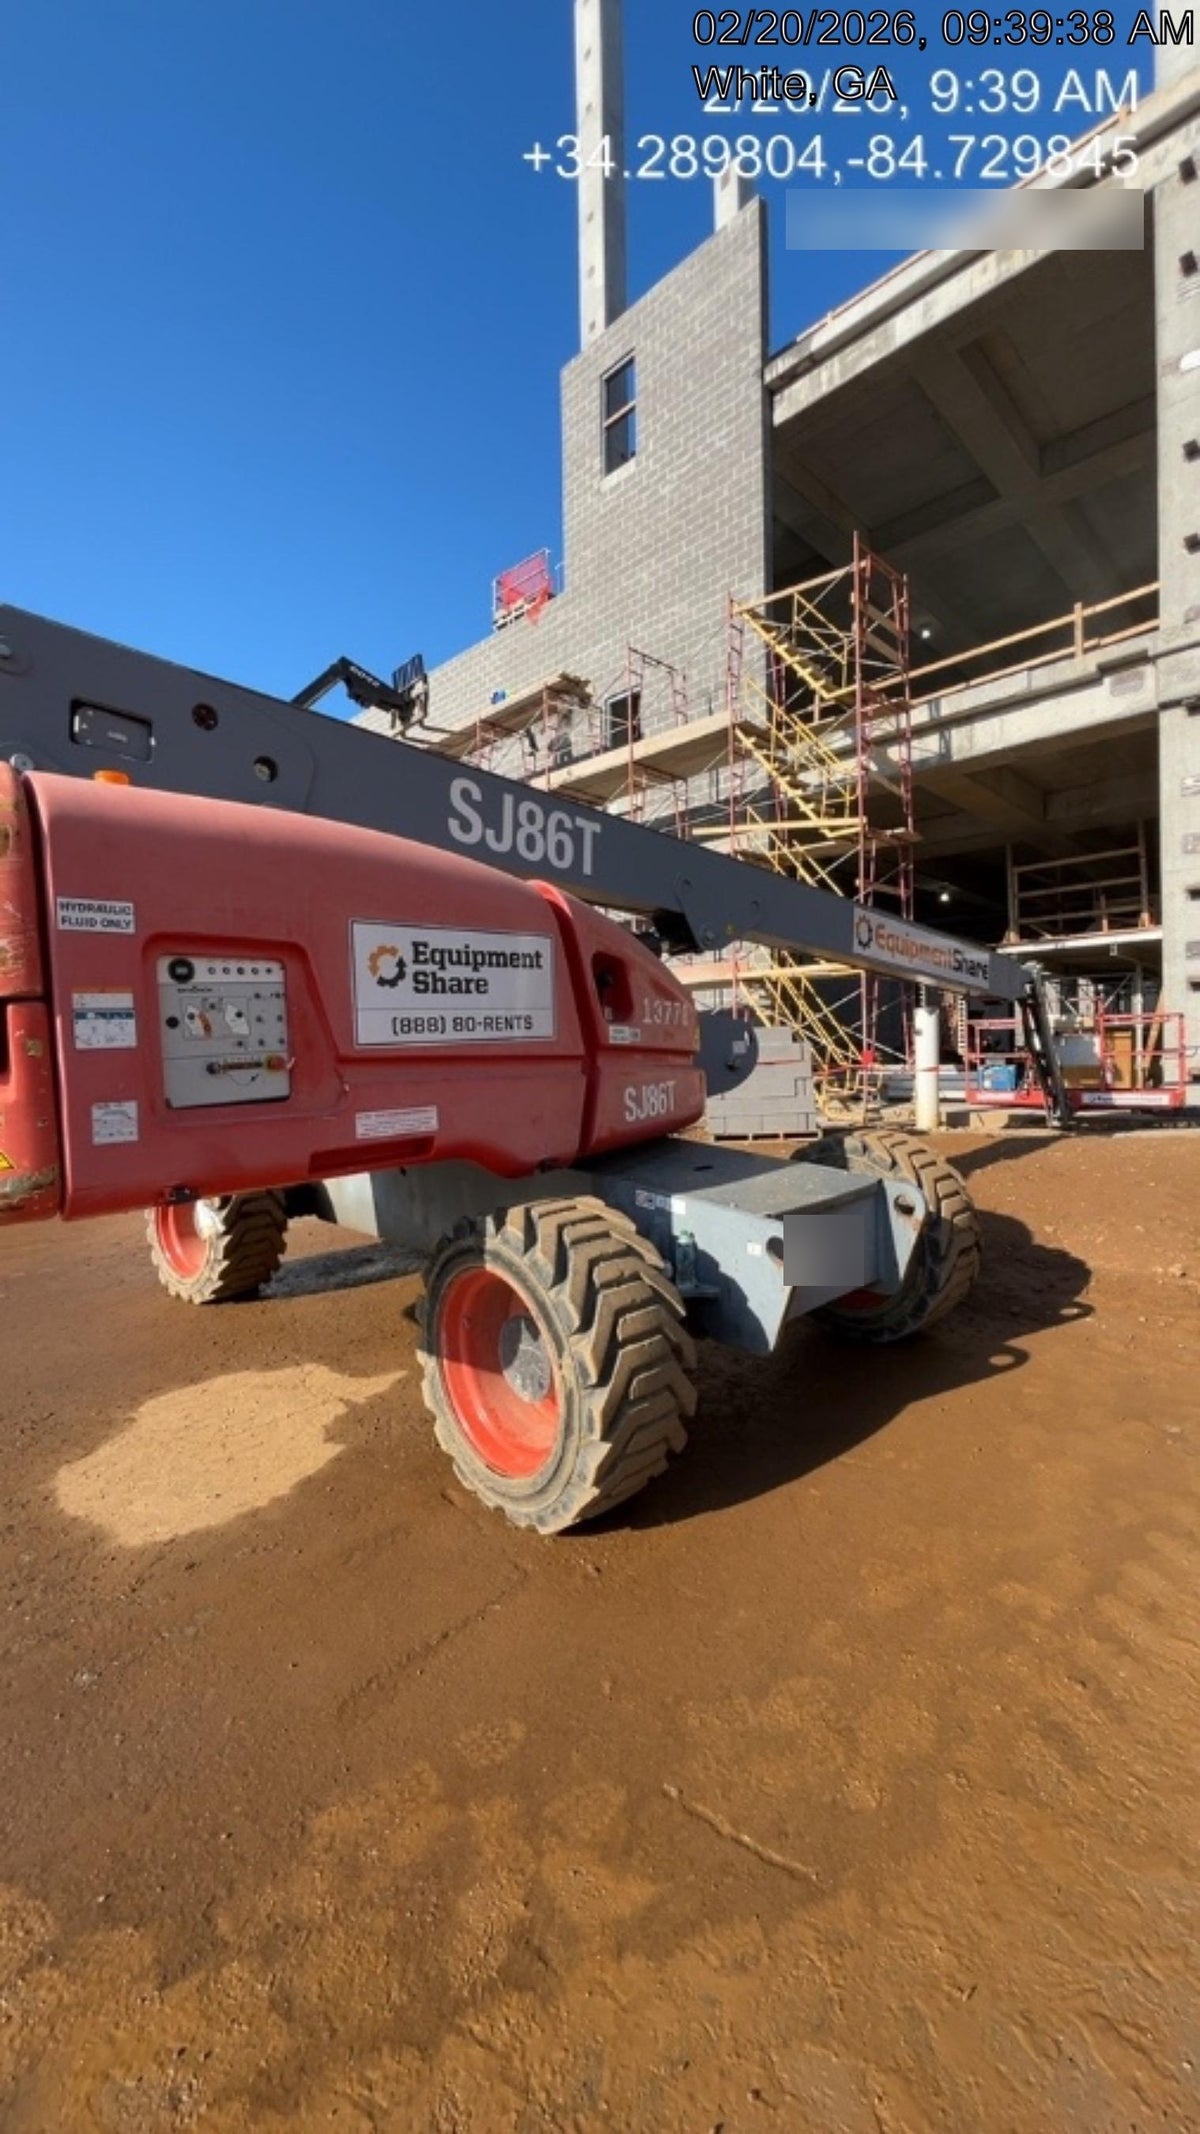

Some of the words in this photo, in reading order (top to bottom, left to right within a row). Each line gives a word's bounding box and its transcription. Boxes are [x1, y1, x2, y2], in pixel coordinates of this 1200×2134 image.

[448, 777, 601, 876] SJ86T
[59, 902, 132, 915] HYDRAULIC
[61, 915, 98, 928] FLUID
[101, 917, 132, 929] ONLY
[411, 941, 544, 972] Equipment
[412, 971, 489, 995] Share
[391, 1015, 447, 1037] (888)
[452, 1014, 533, 1032] 80-RENTS
[624, 1080, 676, 1122] SJ86T
